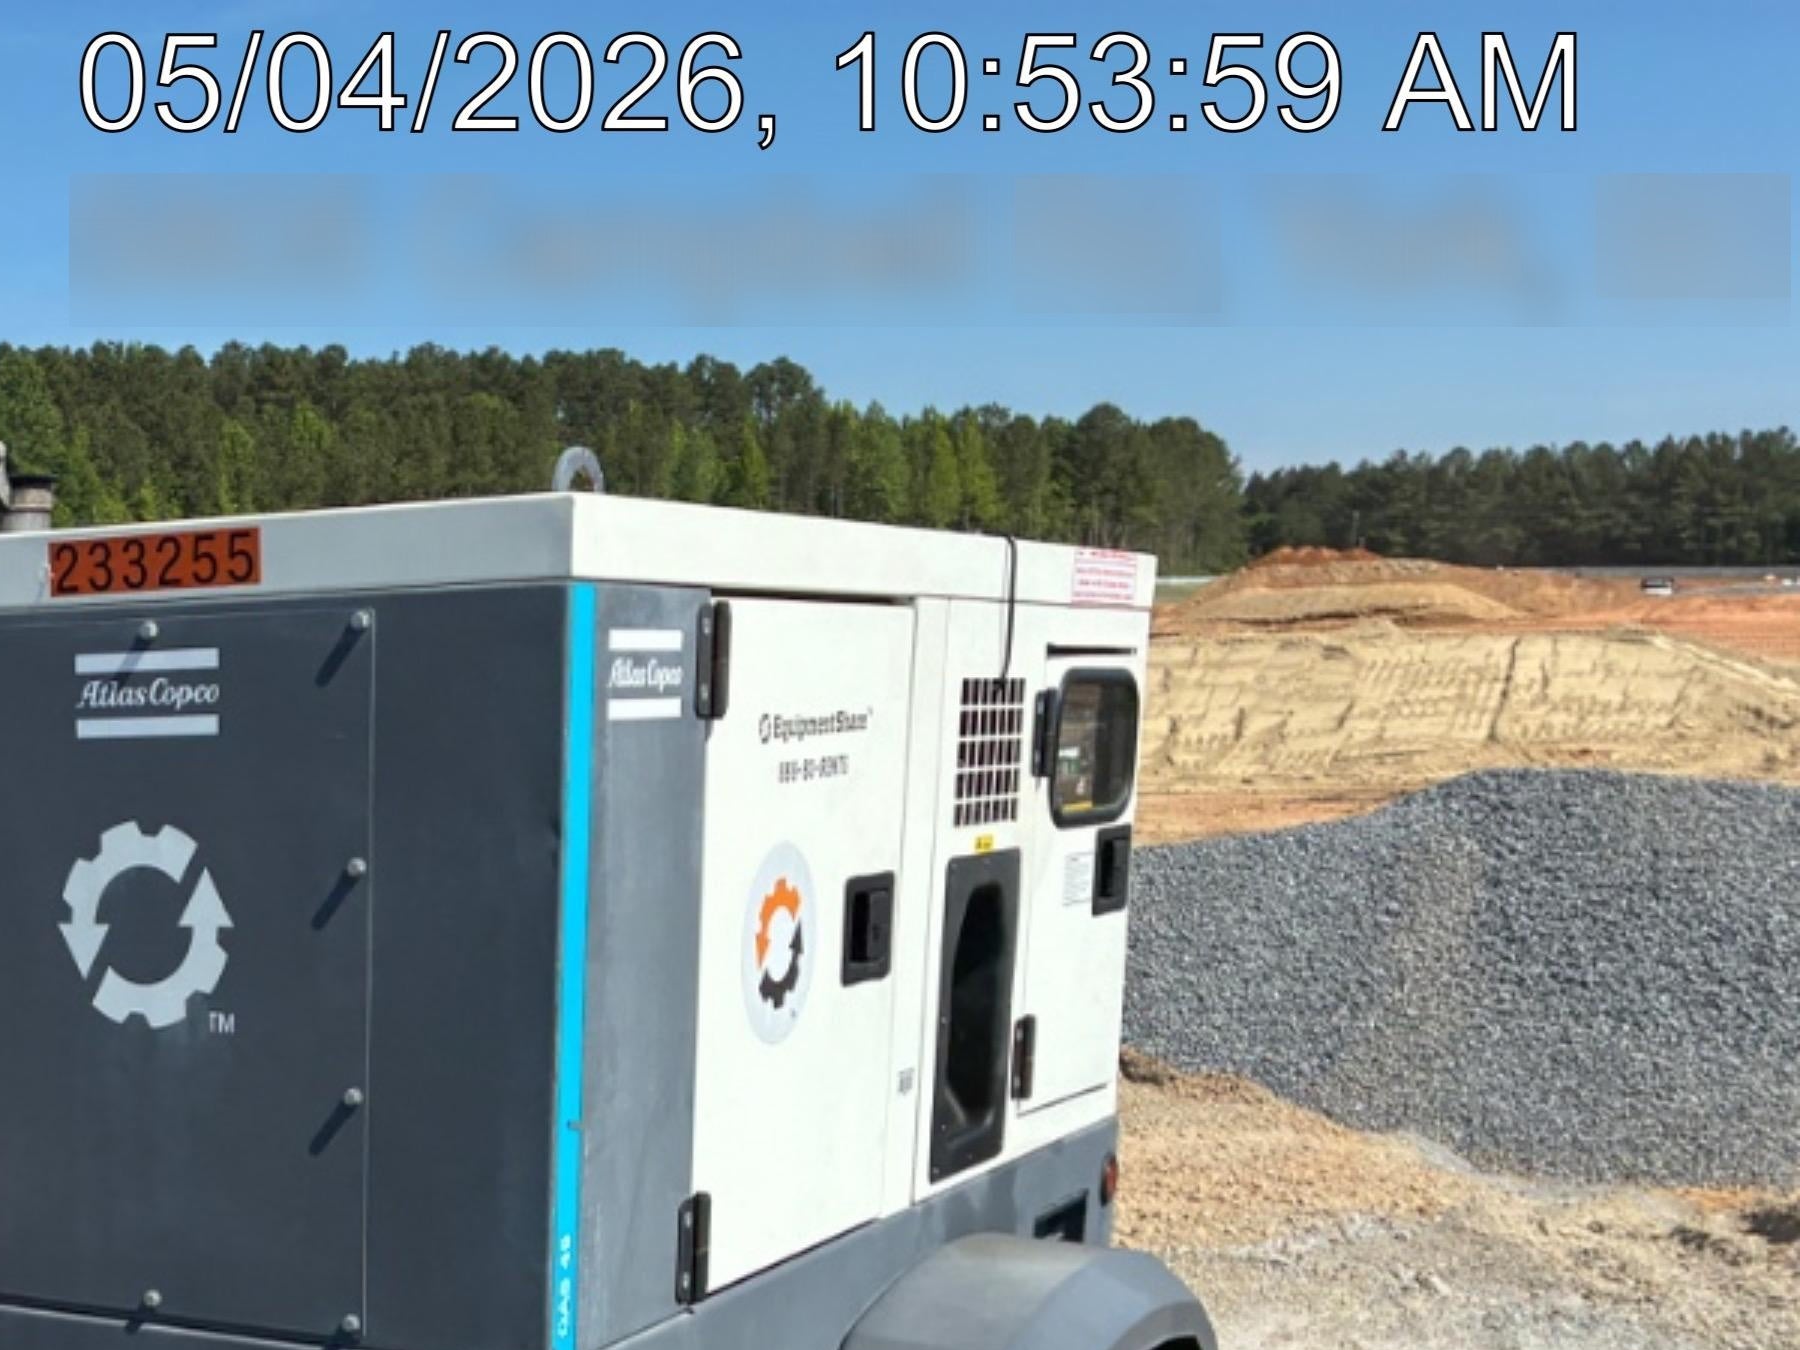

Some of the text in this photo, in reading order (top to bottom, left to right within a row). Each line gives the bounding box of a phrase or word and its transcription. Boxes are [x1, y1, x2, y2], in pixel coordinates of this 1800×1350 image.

[56, 532, 253, 593] 233255
[75, 677, 220, 711] Atlas Copco
[209, 1010, 235, 1035] TM
